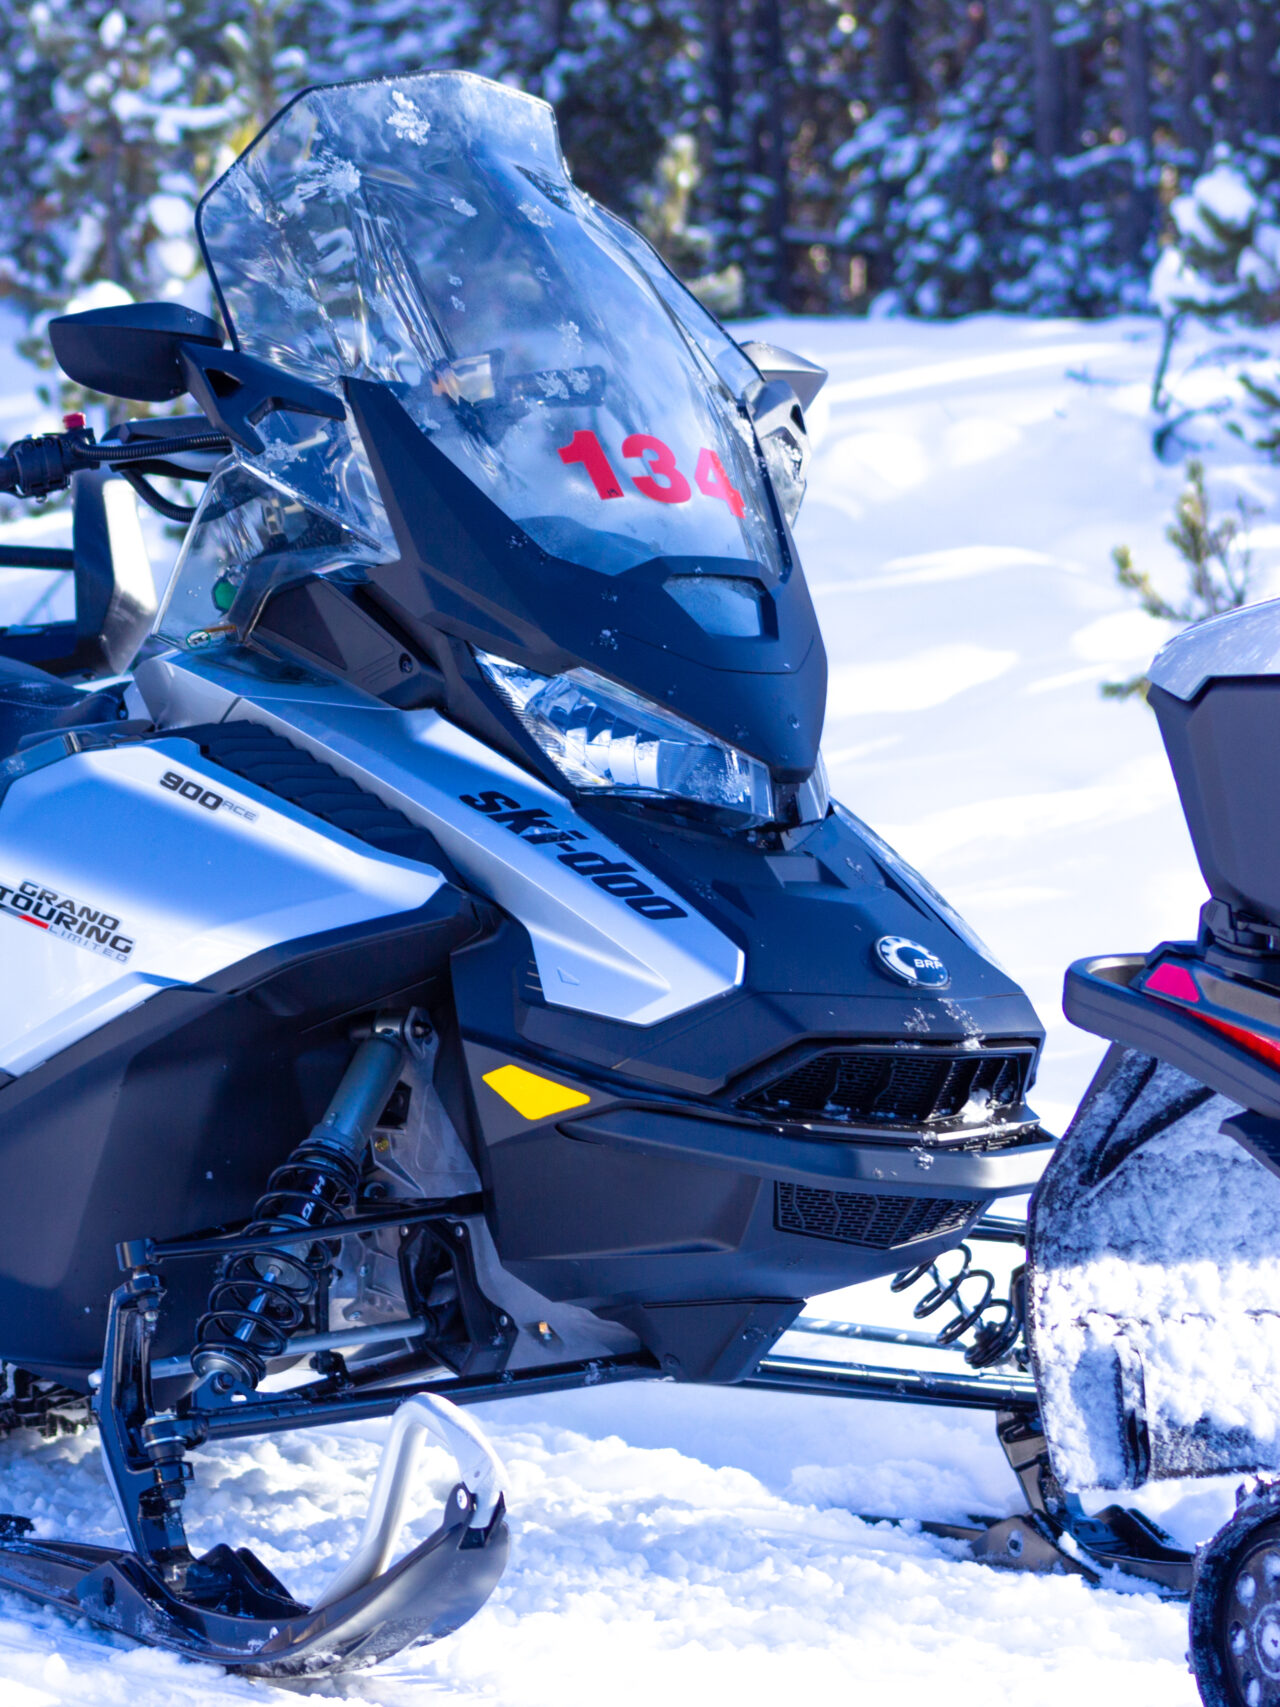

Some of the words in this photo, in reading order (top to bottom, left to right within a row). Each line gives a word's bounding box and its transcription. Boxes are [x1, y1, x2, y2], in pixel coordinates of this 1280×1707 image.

[557, 430, 746, 519] 134
[160, 771, 224, 811] 900
[19, 881, 120, 931] GRAND
[48, 924, 129, 963] LIMITED
[914, 959, 944, 970] BRP
